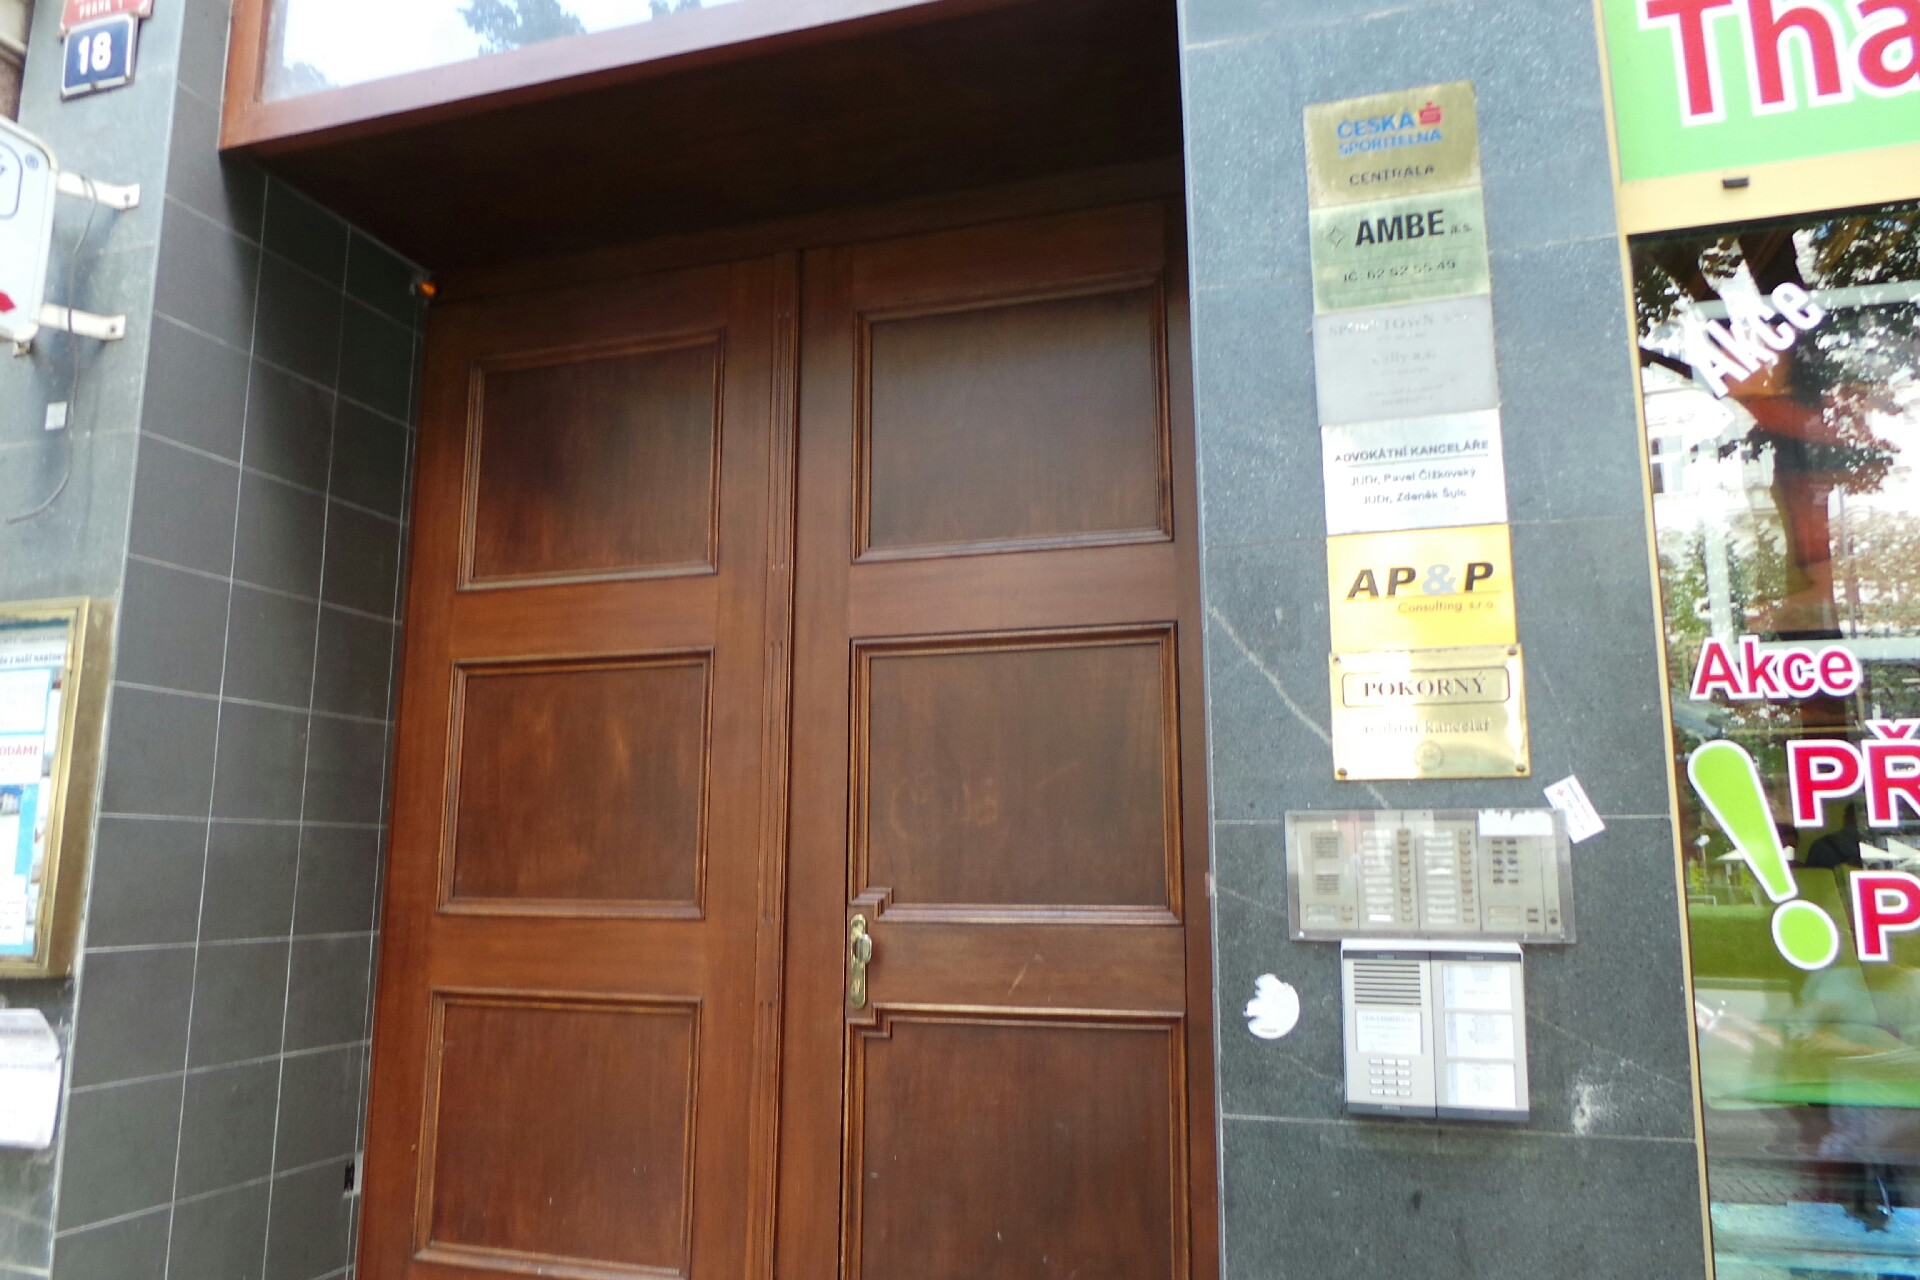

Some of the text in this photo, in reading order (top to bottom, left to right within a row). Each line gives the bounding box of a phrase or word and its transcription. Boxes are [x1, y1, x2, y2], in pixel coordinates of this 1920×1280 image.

[78, 31, 112, 75] 18
[1355, 209, 1445, 246] AMBE
[1383, 471, 1415, 483] Pavel
[1347, 561, 1494, 601] AP&P
[1398, 599, 1463, 614] Consulting
[1363, 671, 1487, 698] POKORNÝ
[1692, 635, 1860, 698] Akce
